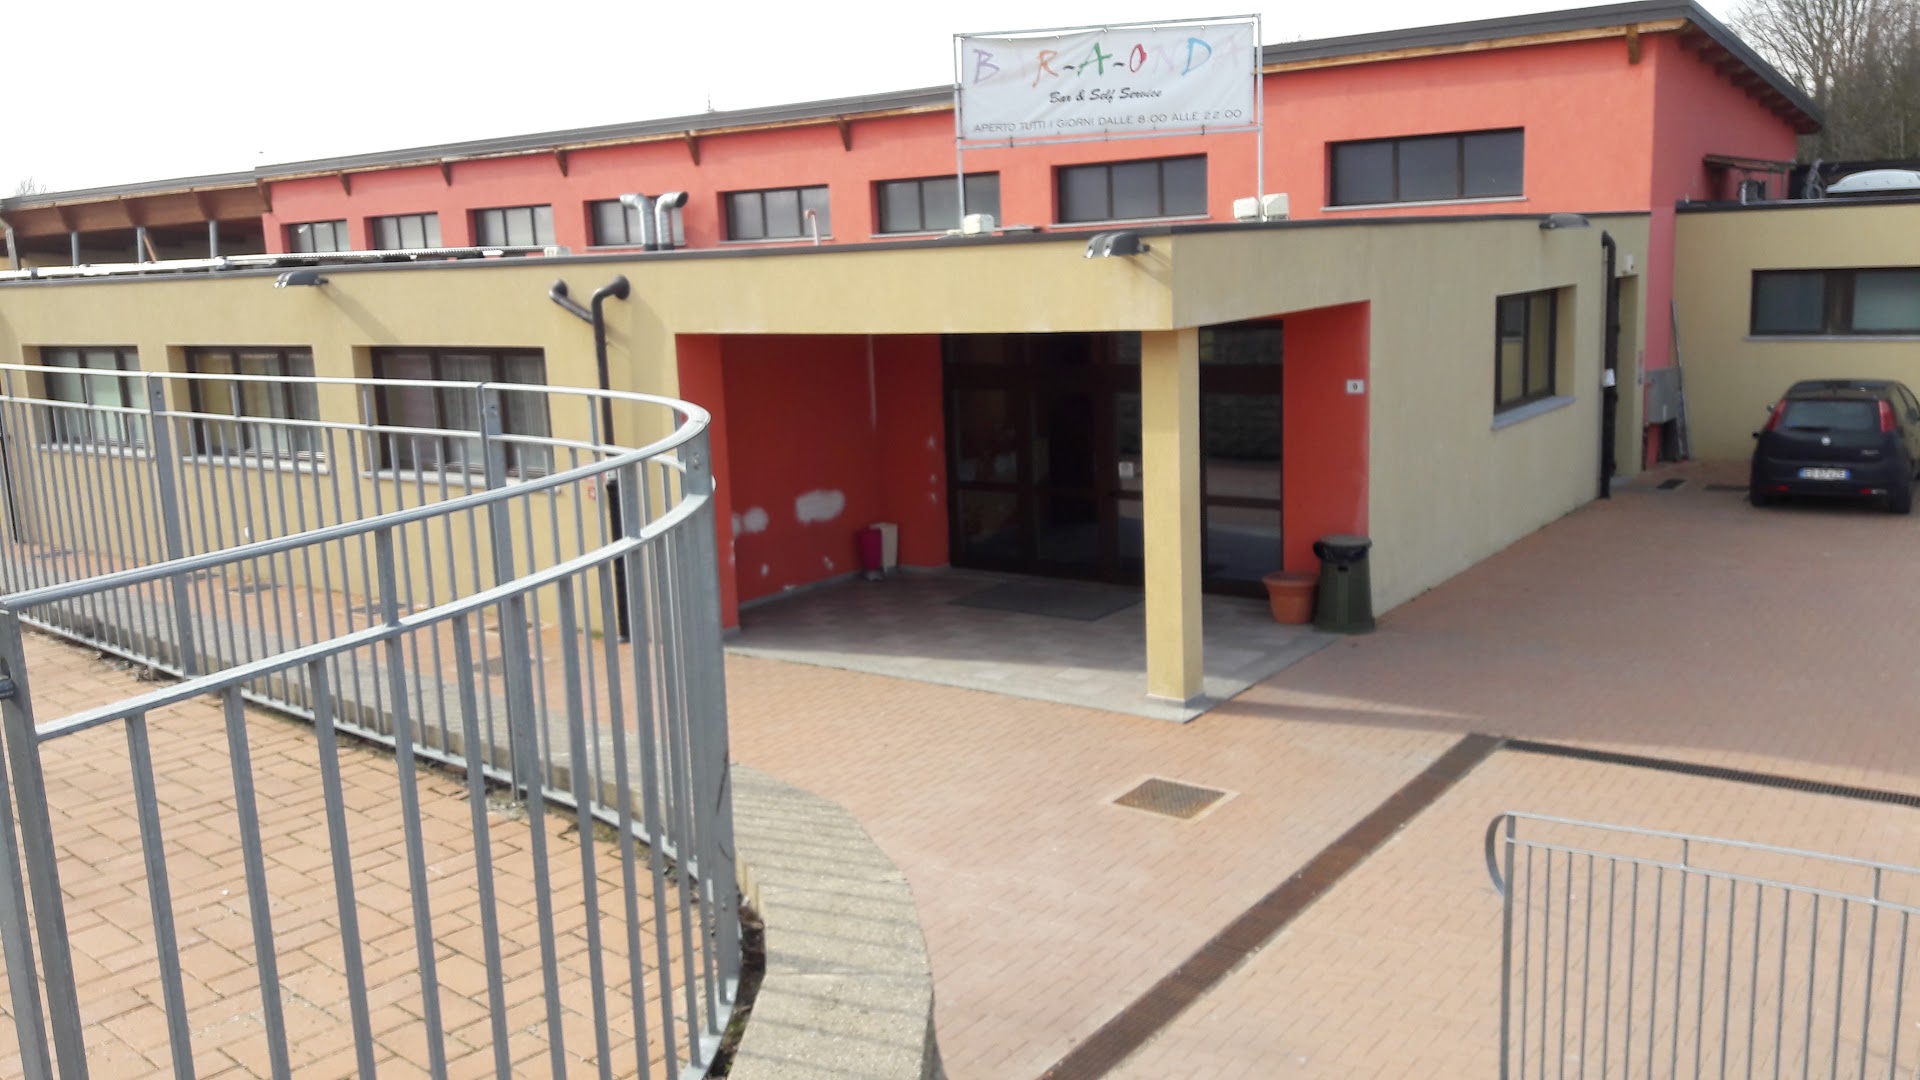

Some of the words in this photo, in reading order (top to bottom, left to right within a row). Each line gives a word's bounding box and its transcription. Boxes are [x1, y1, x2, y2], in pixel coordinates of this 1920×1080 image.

[1049, 91, 1072, 103] Bar
[1076, 89, 1086, 101] &
[1089, 88, 1116, 103] Self
[1119, 87, 1162, 99] Service
[974, 122, 1016, 133] APERTO
[1020, 120, 1046, 131] TUTTI
[1057, 117, 1095, 129] GIORNI
[1099, 115, 1134, 126] DALLE
[1171, 111, 1200, 122] ALLE
